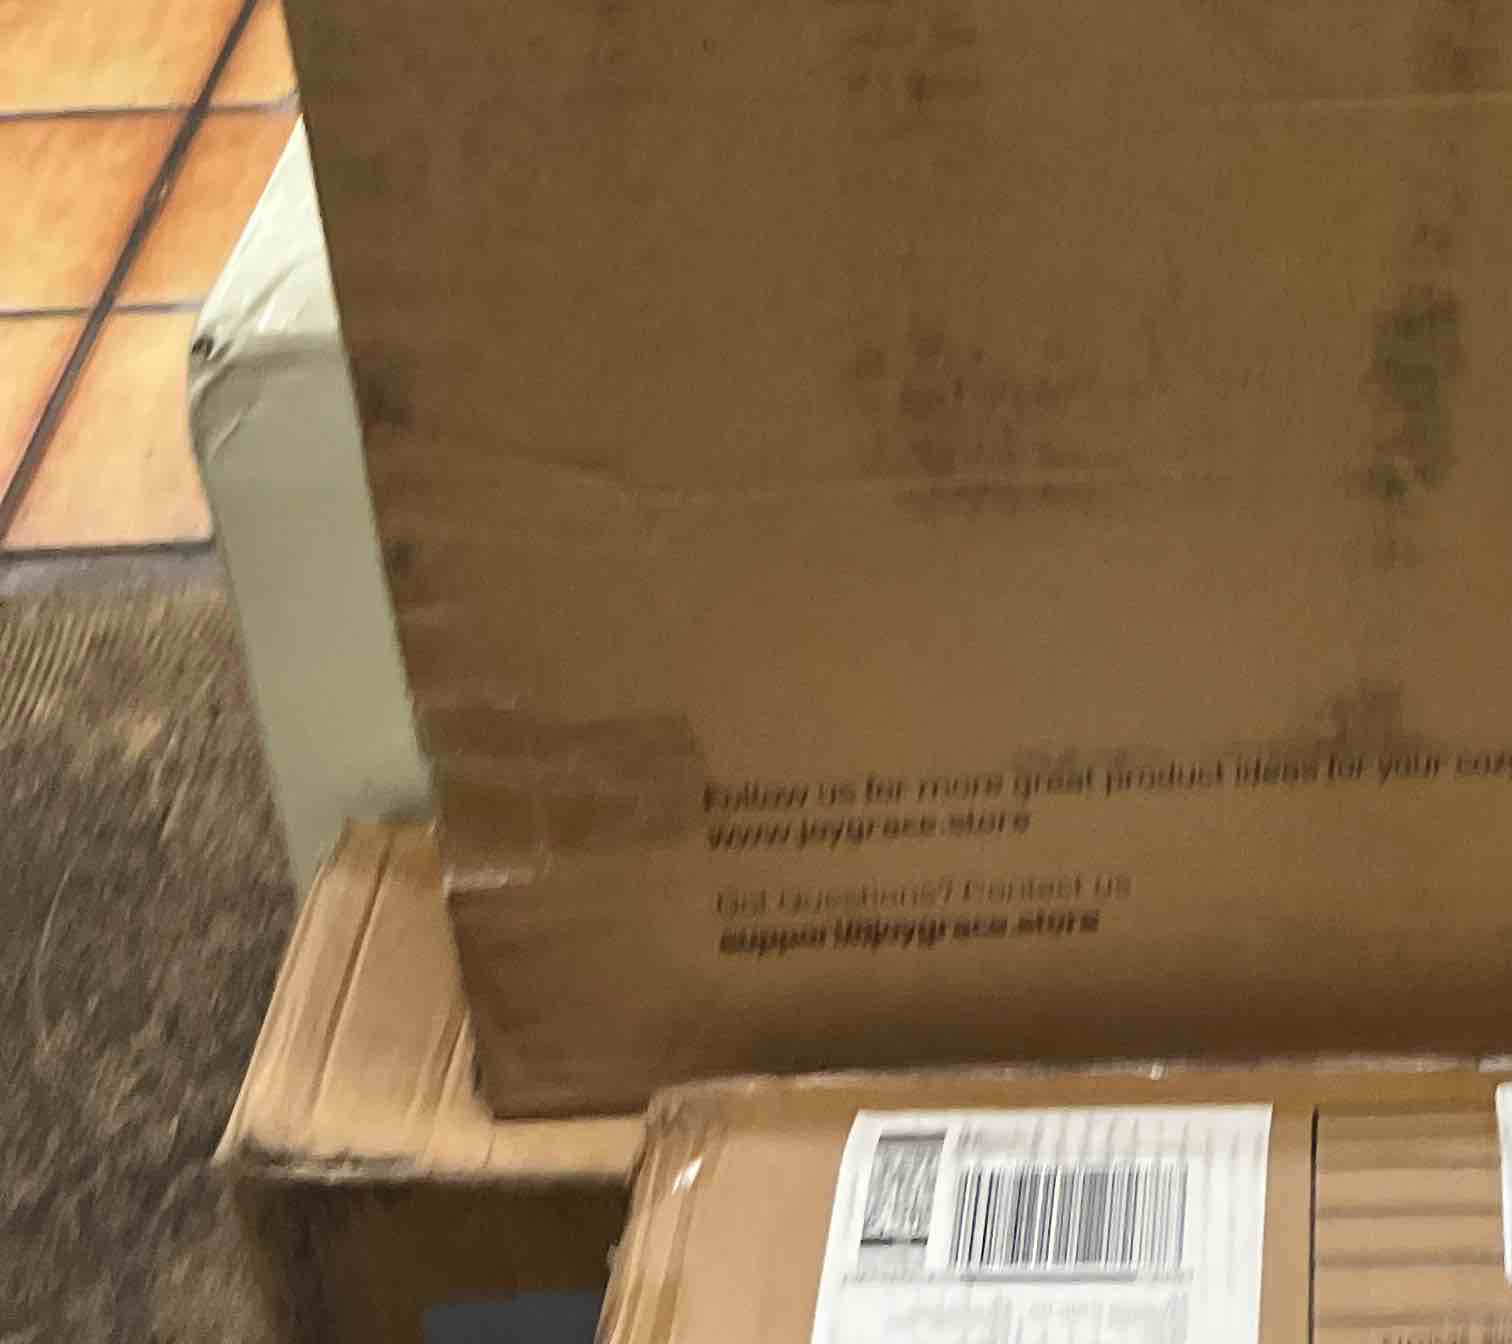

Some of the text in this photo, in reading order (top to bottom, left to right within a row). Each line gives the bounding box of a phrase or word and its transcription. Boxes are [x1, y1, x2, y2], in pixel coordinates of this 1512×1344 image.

[704, 780, 807, 812] Follow
[1012, 767, 1093, 804] great
[1104, 759, 1223, 799] product
[1235, 756, 1319, 788] ideas
[1376, 750, 1440, 785] your
